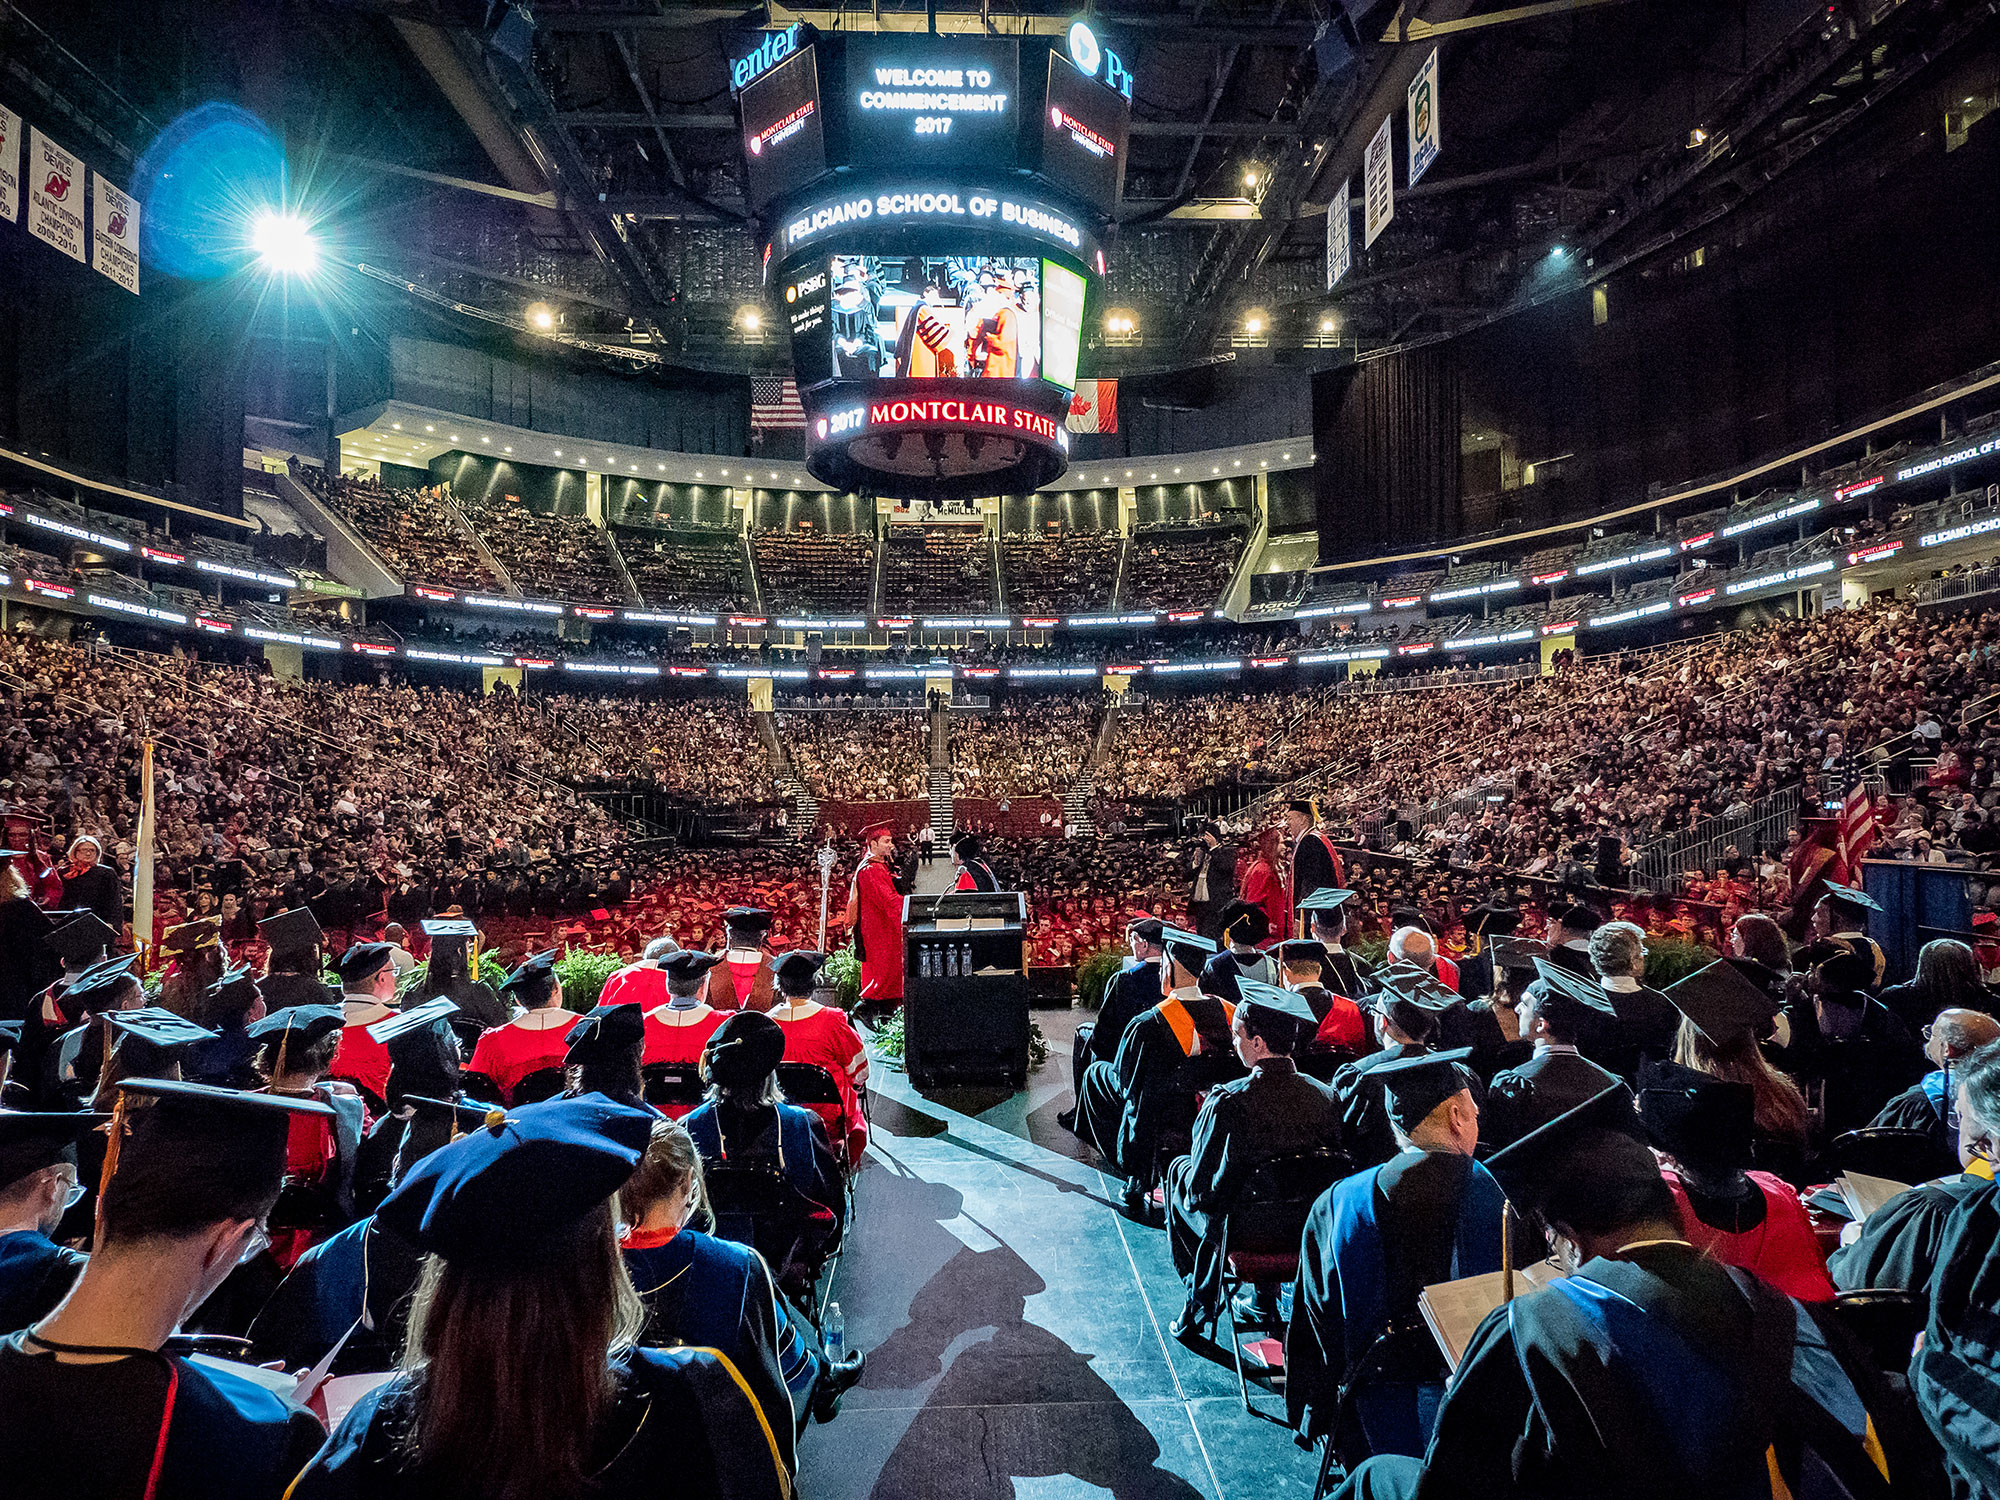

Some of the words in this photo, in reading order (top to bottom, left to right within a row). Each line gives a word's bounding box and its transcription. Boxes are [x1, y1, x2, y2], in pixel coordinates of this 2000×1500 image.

[735, 22, 799, 88] enter
[875, 69, 963, 87] WELCOME
[965, 70, 991, 88] TO
[1105, 47, 1133, 99] Pr
[860, 92, 1007, 111] COMMENCEMENT
[760, 111, 796, 141] MONTCLAIR
[795, 100, 815, 119] STATE
[914, 117, 953, 134] 2017
[1062, 113, 1098, 143] MONTCLAIR
[1097, 136, 1115, 154] STATE
[44, 150, 72, 178] DEVILS
[105, 192, 130, 216] DEVILS
[789, 198, 873, 244] FELICIANO
[876, 194, 965, 215] SCHOOL
[969, 196, 998, 217] OF
[1002, 201, 1080, 247] BUSINESS
[36, 223, 78, 254] 2009-2010
[101, 261, 134, 288] 2011-2012
[829, 407, 866, 434] 2017
[870, 401, 1007, 425] MONTCLAIR
[1013, 409, 1056, 440] STATE
[1941, 448, 1980, 465] SCHOOL
[1980, 442, 1994, 453] OF
[937, 506, 982, 516] McMULLEN
[1752, 513, 1777, 527] SCHOOL
[63, 525, 90, 540] SCHOOL
[1759, 573, 1787, 586] SCHOOL
[123, 603, 149, 615] SCHOOL
[1250, 599, 1300, 611] stand
